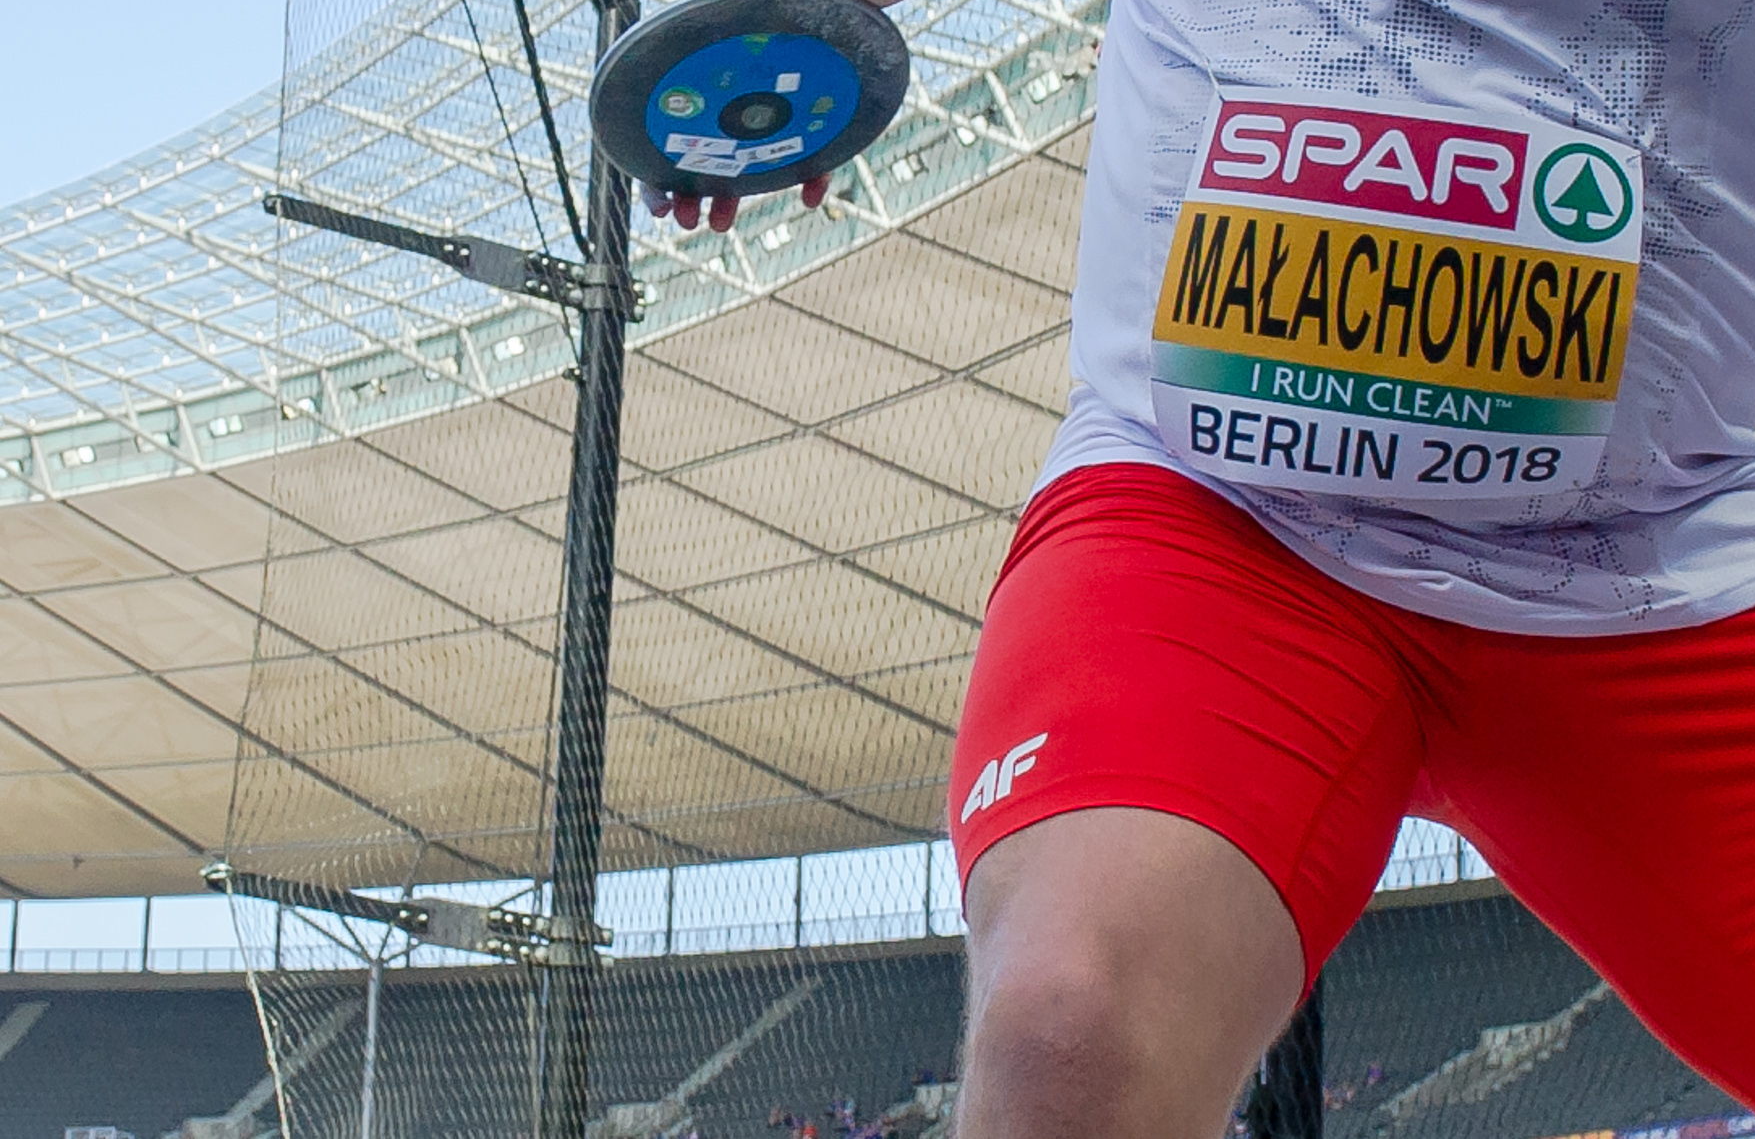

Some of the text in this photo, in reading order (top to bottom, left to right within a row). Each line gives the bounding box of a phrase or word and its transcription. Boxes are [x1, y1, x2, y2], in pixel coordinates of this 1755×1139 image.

[1212, 113, 1516, 215] SPAR
[1172, 213, 1622, 384] MAŁACHOWSKI
[1250, 363, 1261, 393] I
[1272, 367, 1354, 406] RUN
[1191, 403, 1562, 484] BERLIN 2018
